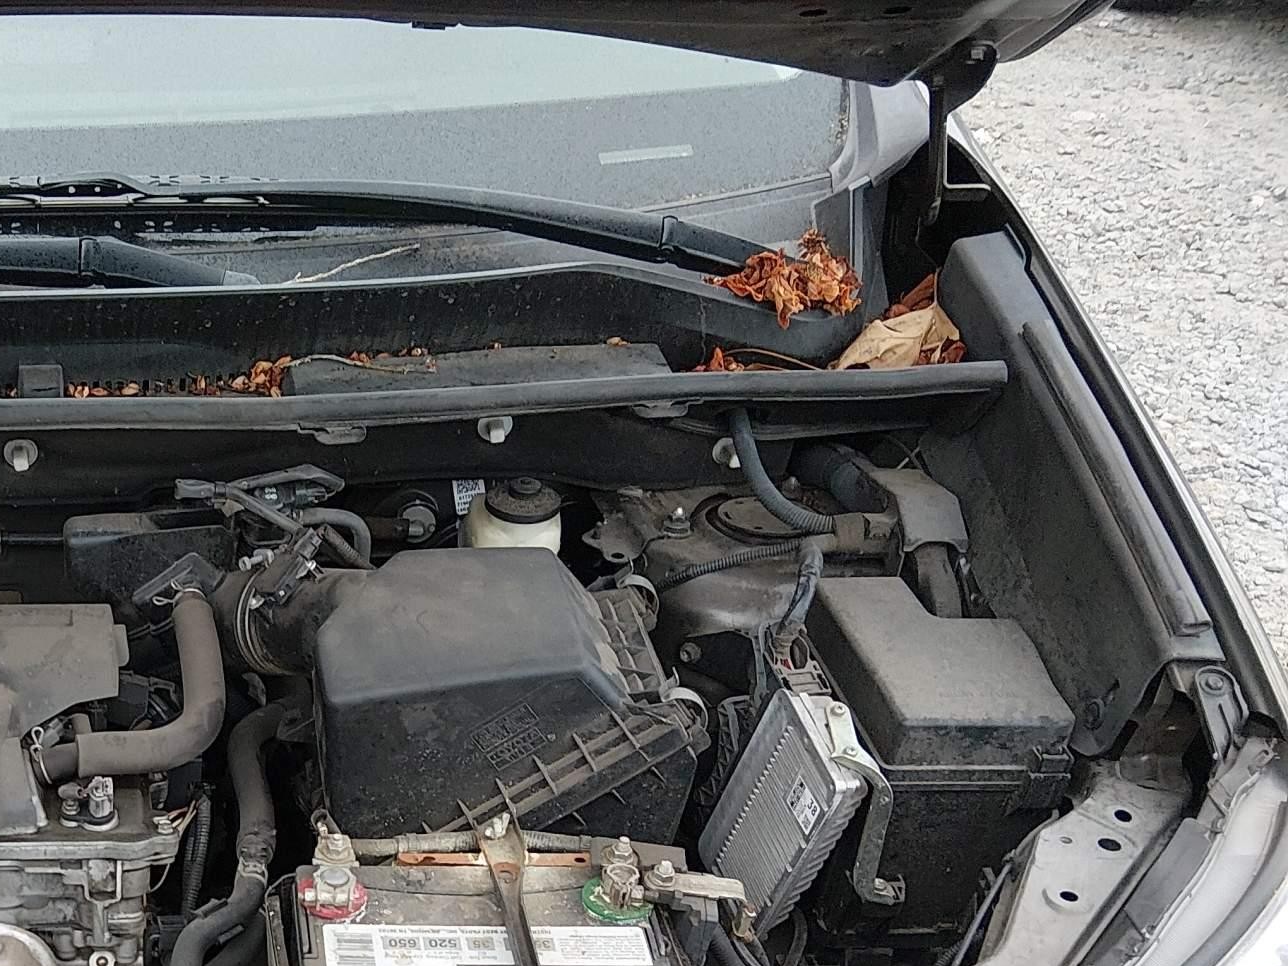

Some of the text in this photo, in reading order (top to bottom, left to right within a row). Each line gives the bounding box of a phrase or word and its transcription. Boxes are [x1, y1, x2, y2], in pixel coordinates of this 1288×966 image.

[806, 798, 818, 817] 38
[388, 938, 417, 948] 650
[429, 938, 458, 948] 520
[473, 938, 491, 948] 35
